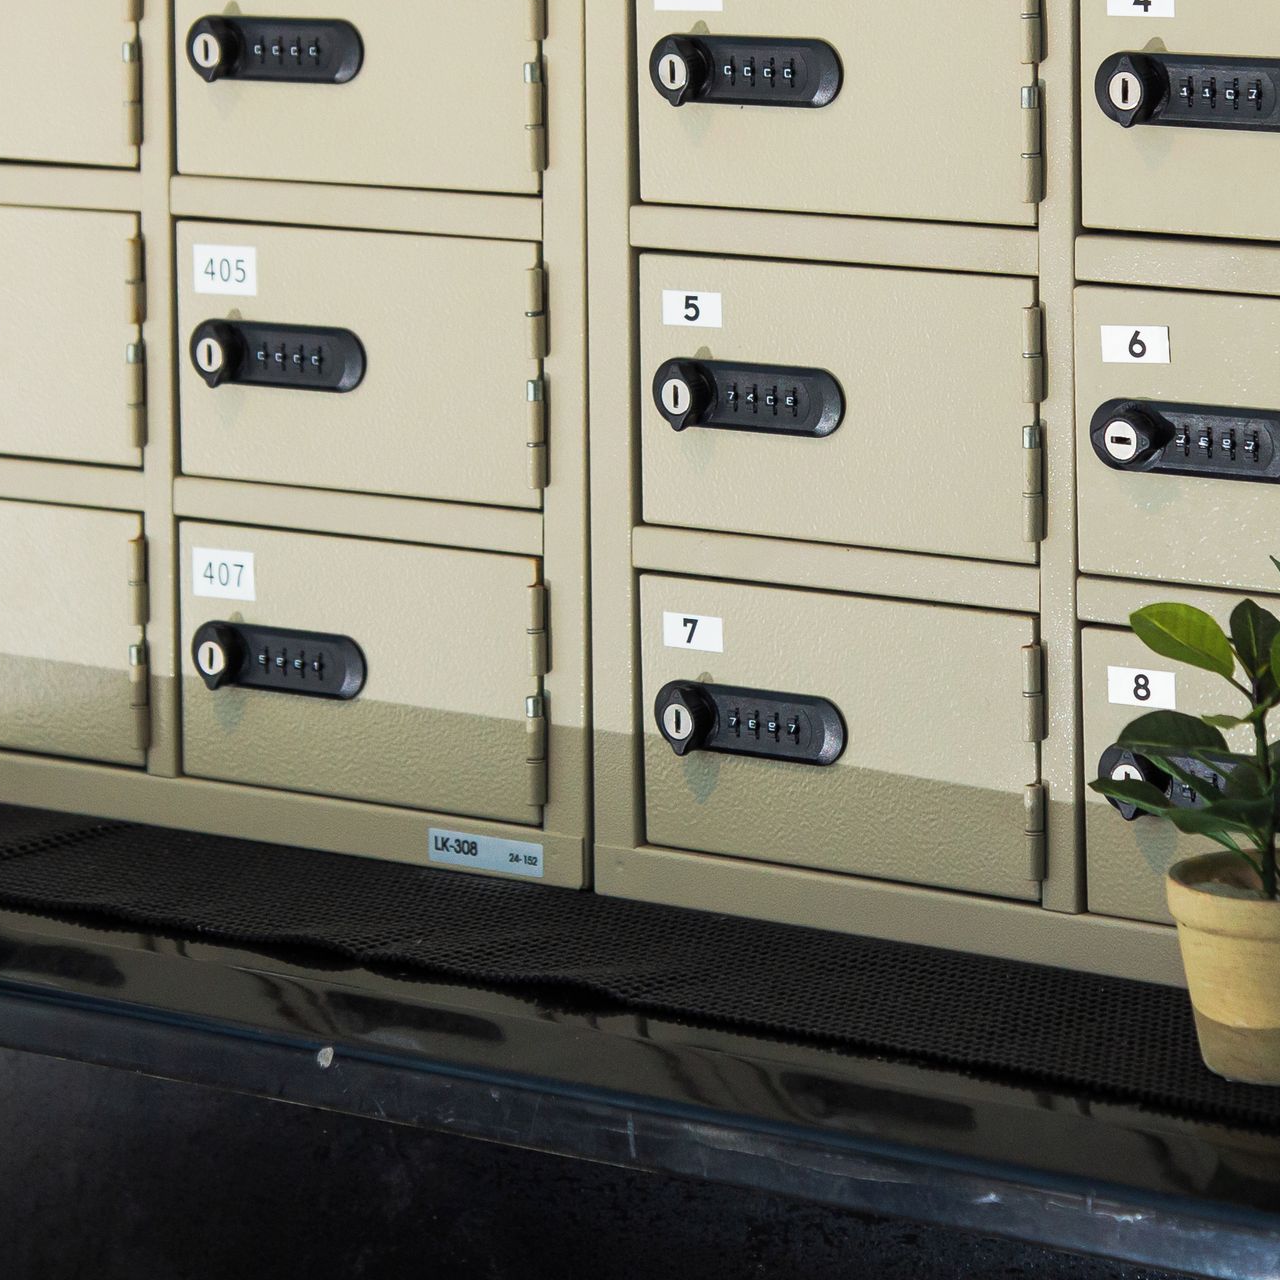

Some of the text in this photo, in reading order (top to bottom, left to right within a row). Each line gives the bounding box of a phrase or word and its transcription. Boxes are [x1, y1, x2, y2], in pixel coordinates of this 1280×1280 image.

[203, 257, 246, 284] 405
[683, 295, 700, 322] 5
[1127, 330, 1147, 359] 6
[203, 561, 245, 587] 407
[682, 617, 699, 644] 7
[1132, 673, 1152, 703] 8
[434, 835, 538, 867] LK-308 24-152
